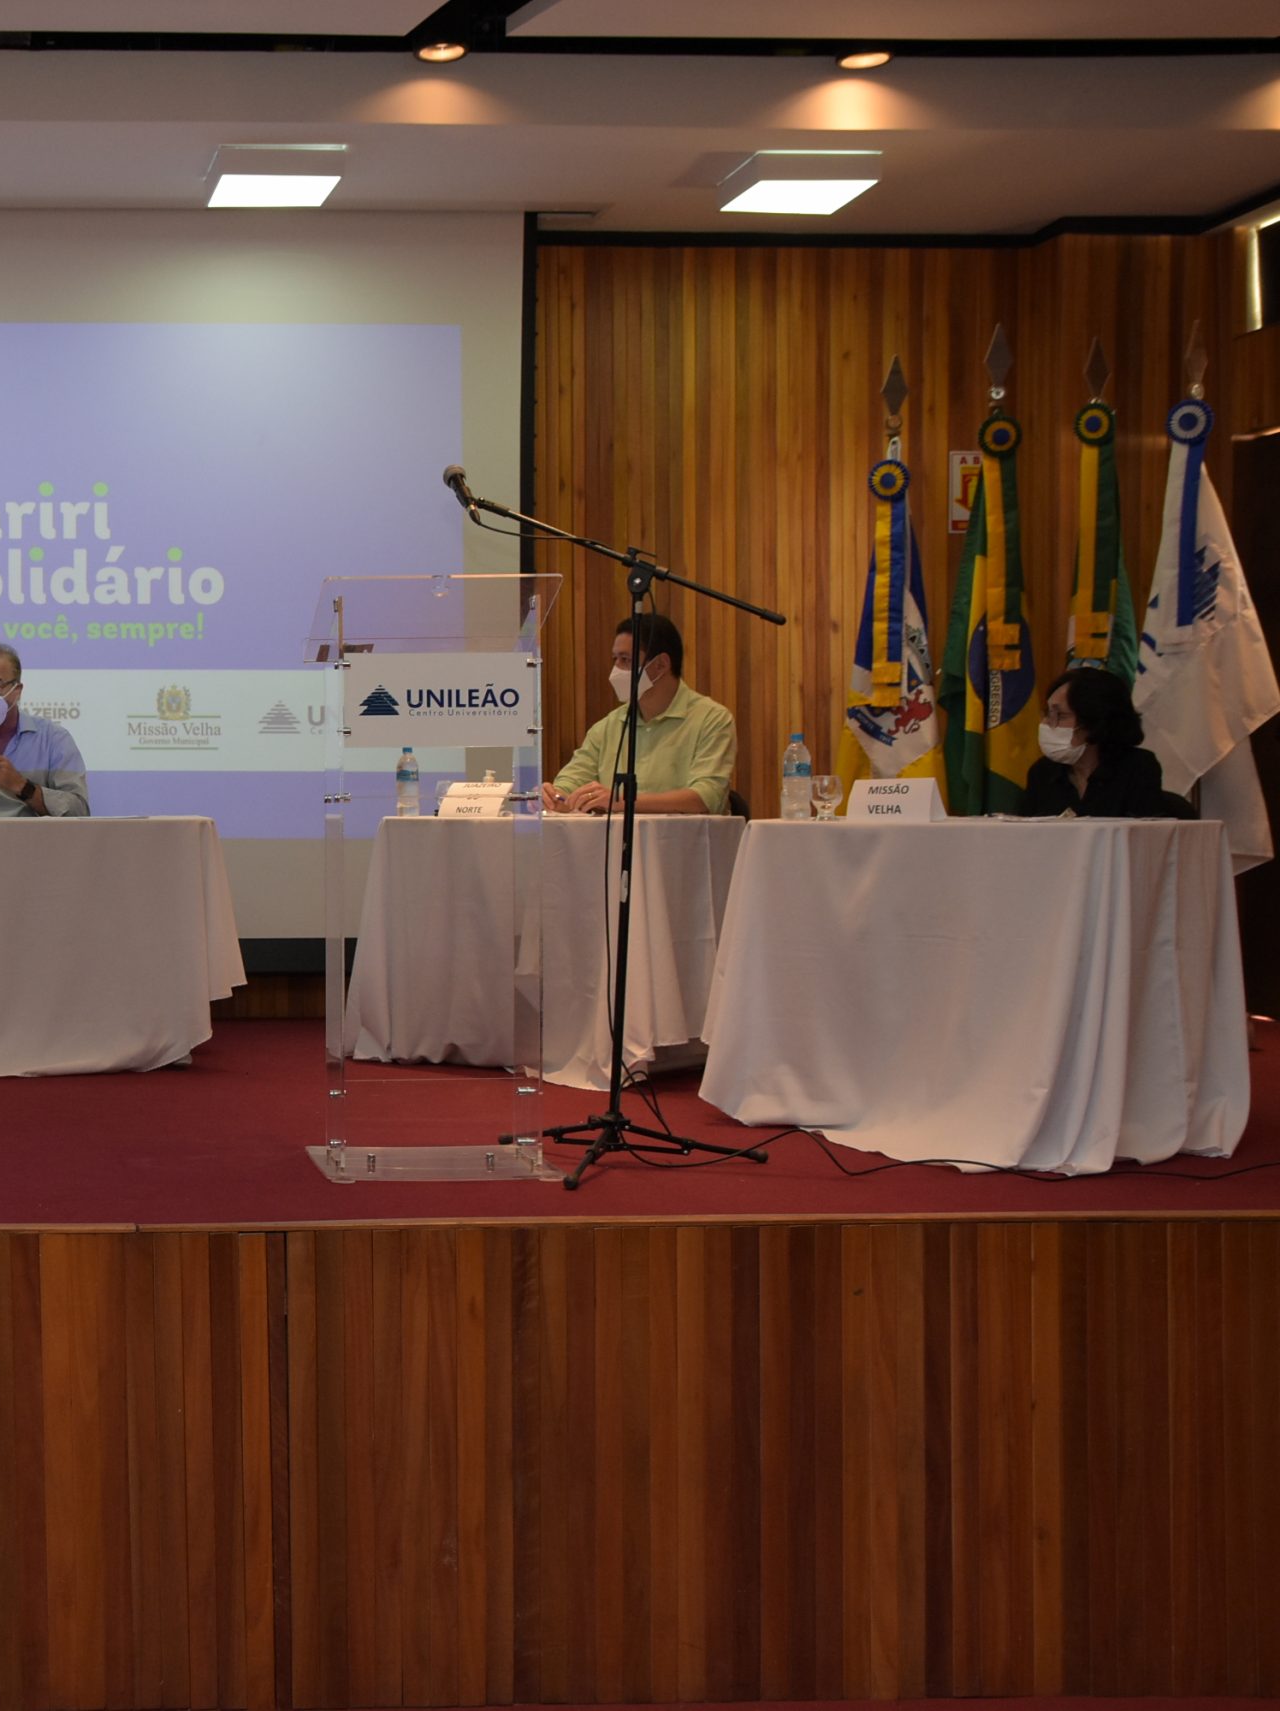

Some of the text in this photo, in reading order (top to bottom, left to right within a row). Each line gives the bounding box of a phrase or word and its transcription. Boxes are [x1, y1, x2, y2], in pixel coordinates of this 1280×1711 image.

[3, 613, 79, 643] você,
[86, 610, 205, 647] sempre!
[406, 683, 520, 708] UNILEÃO
[408, 708, 519, 717] Centro Universitário
[127, 721, 222, 737] Missão Velha
[867, 783, 910, 795] MISSÃO
[455, 806, 483, 814] NORTE
[867, 804, 902, 815] VELHA
